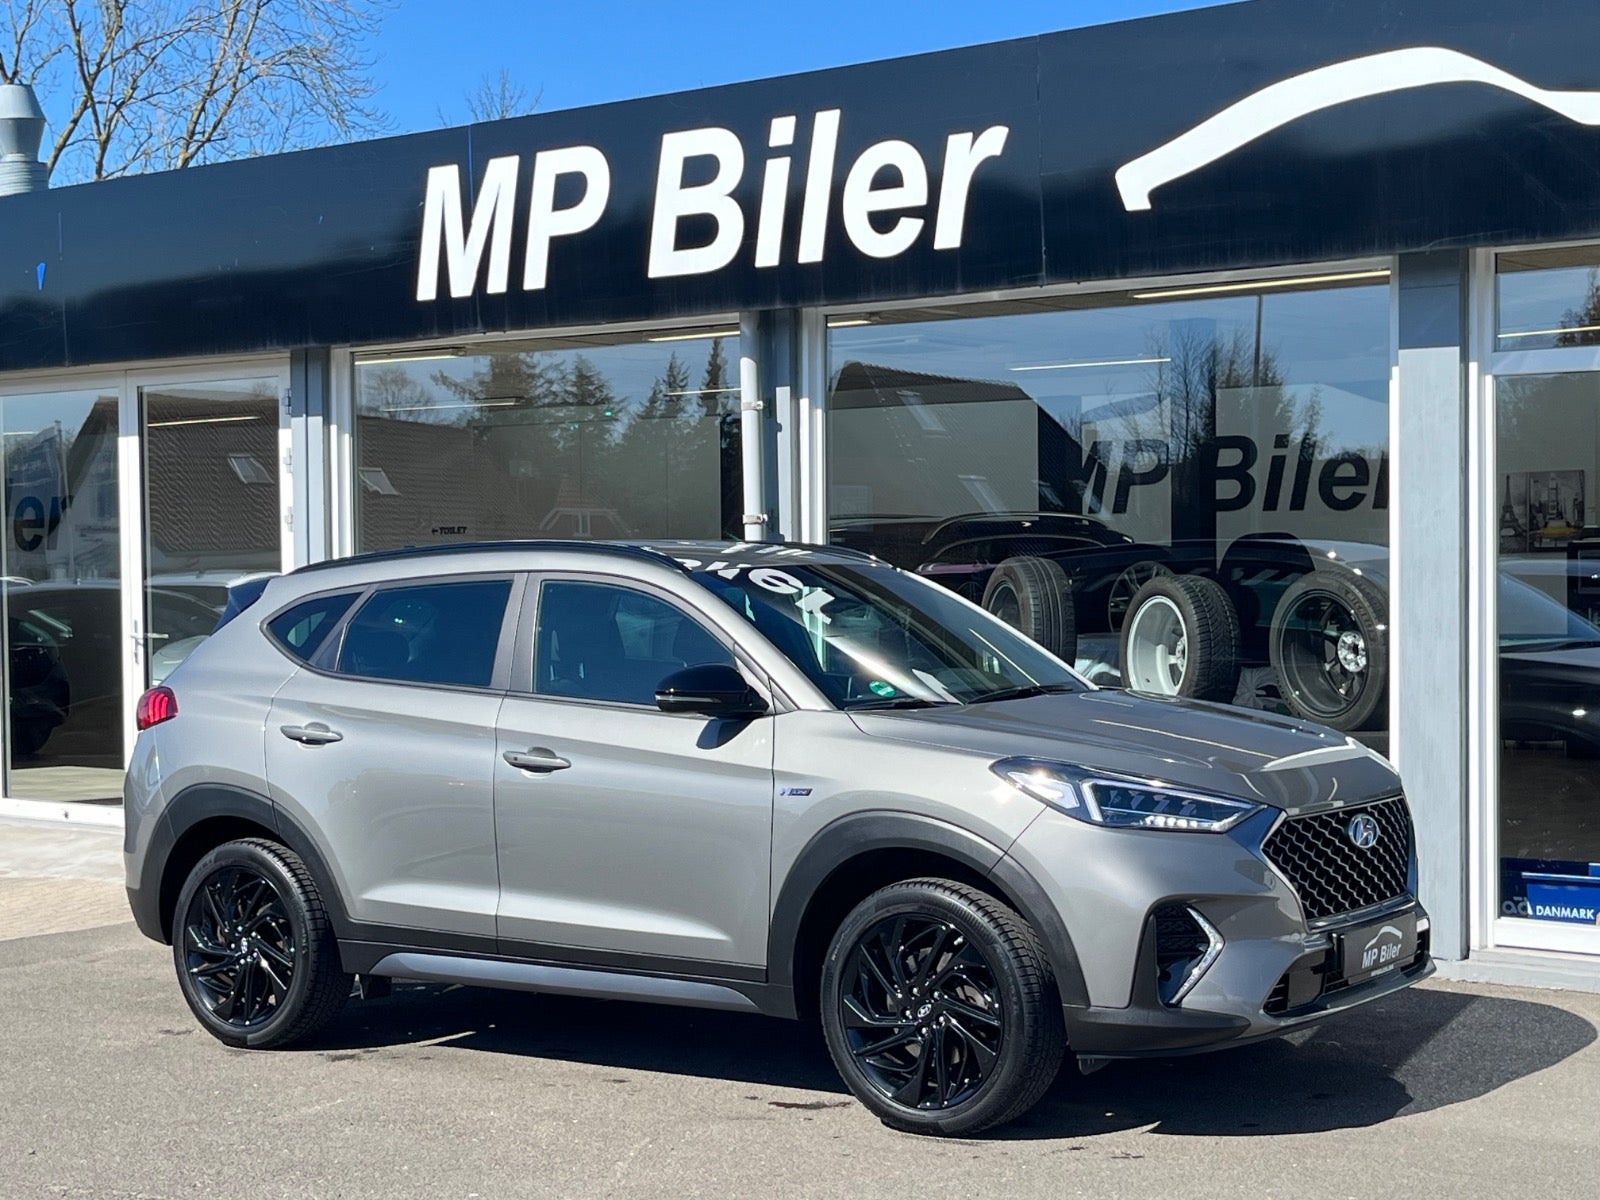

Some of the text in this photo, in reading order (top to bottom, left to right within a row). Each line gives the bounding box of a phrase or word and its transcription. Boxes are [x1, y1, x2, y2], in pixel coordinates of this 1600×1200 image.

[416, 109, 1009, 302] MP Biler
[1536, 905, 1595, 919] DANMARK
[1362, 943, 1401, 968] MP Biler
